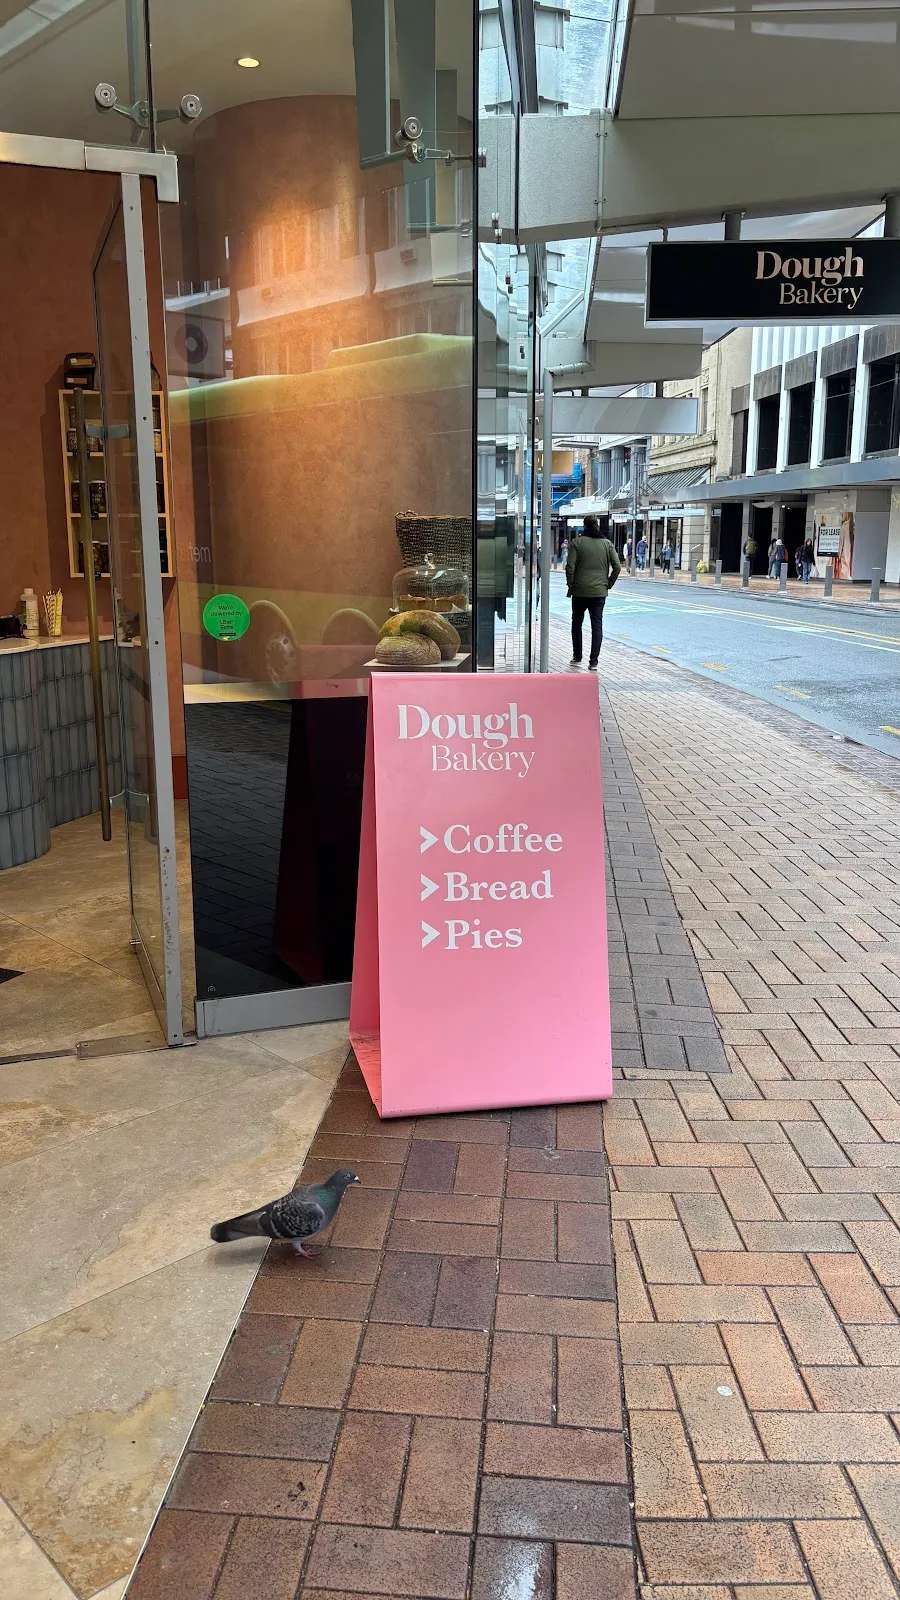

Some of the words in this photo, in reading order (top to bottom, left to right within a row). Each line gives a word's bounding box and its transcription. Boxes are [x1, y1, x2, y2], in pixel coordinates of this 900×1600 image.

[755, 247, 864, 286] Dough
[779, 281, 864, 309] Bakery
[828, 528, 841, 536] LEASE
[397, 702, 535, 749] Dough
[431, 744, 536, 778] Bakery
[443, 823, 563, 855] Coffee
[443, 869, 553, 902] Bread
[444, 918, 523, 950] Pies
